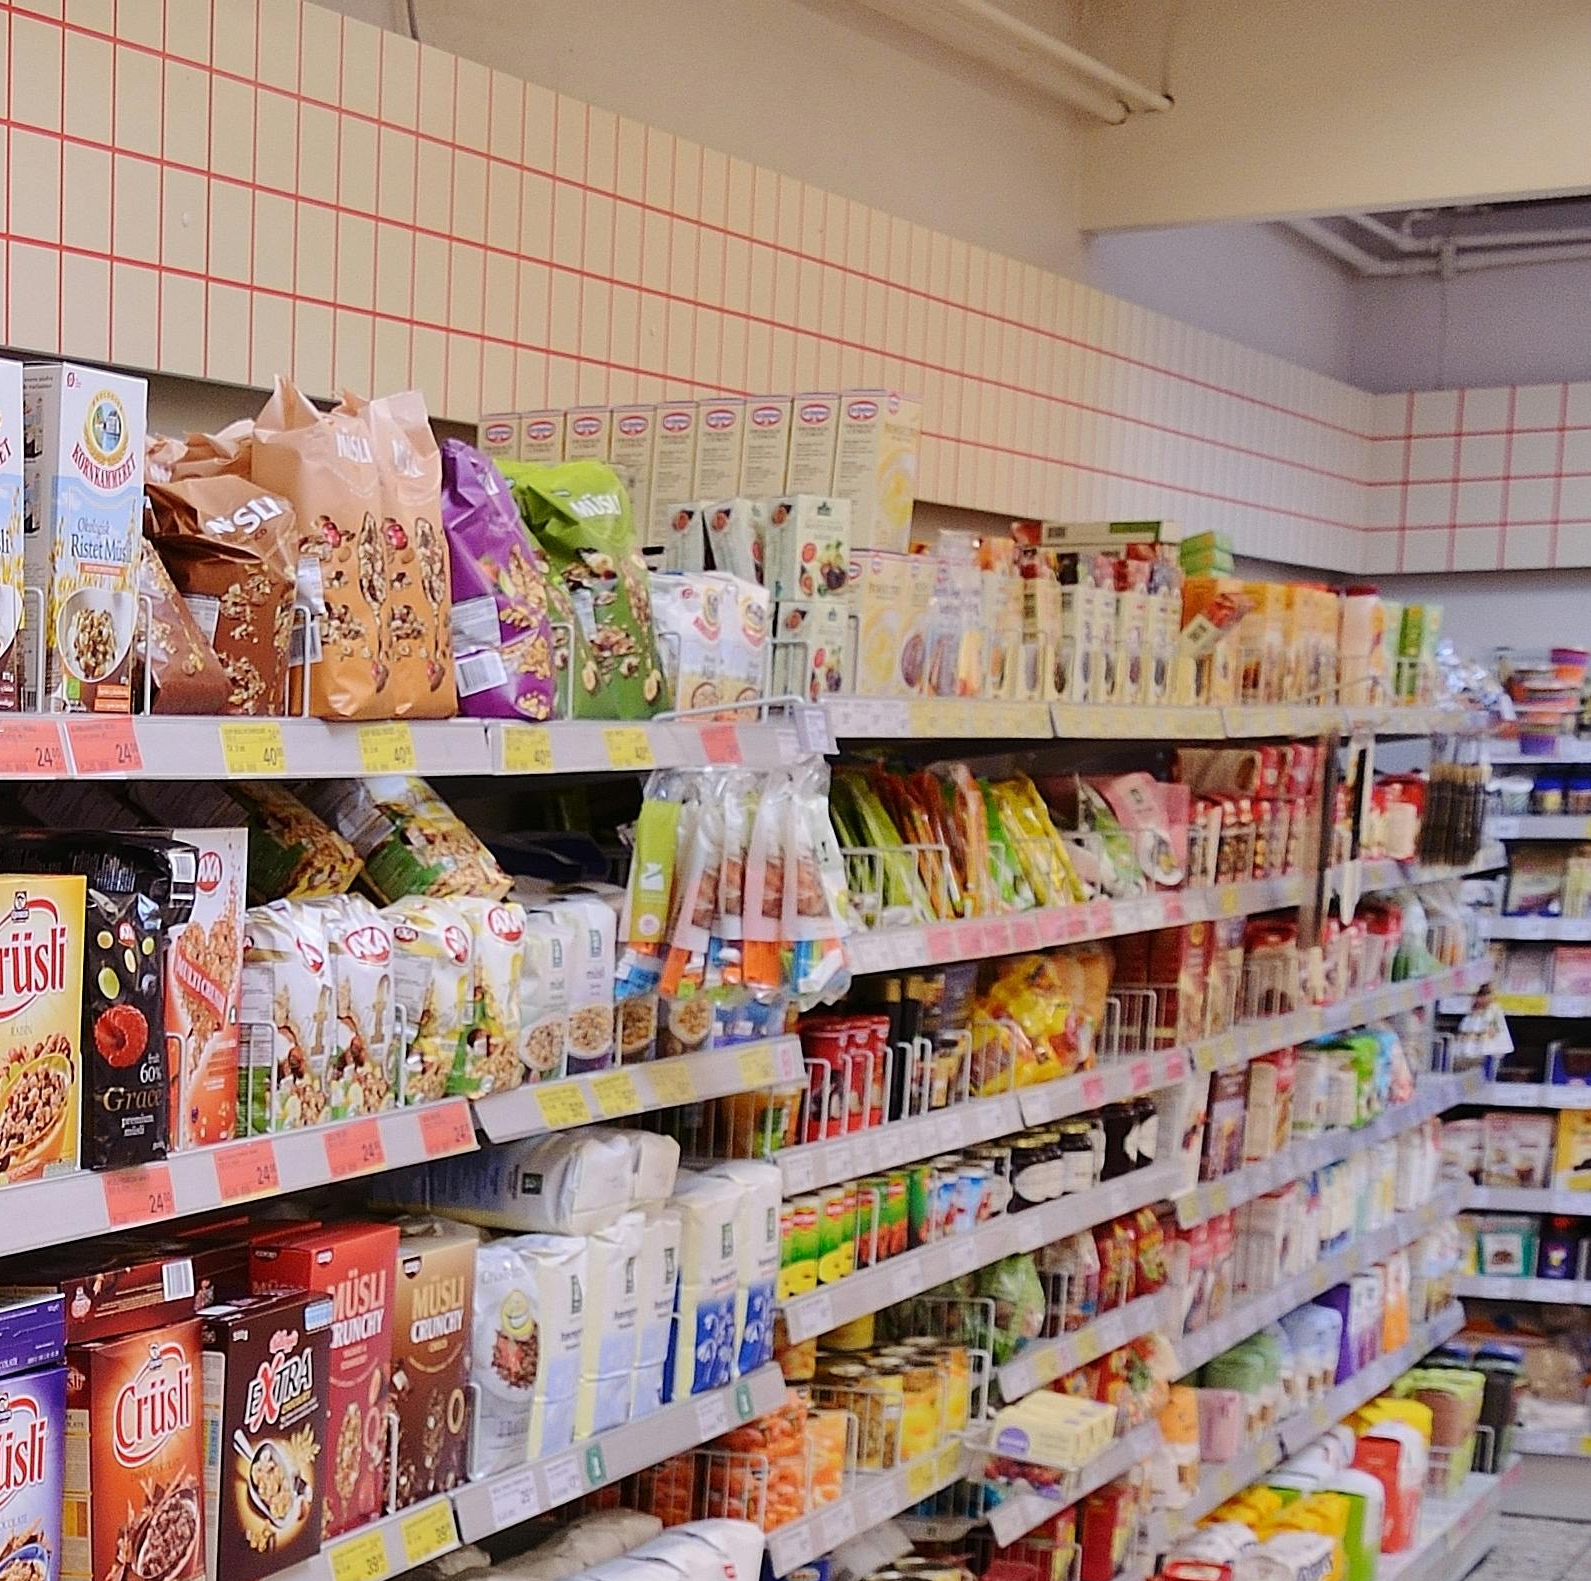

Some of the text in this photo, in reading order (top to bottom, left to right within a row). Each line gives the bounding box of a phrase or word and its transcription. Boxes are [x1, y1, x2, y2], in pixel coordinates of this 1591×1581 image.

[71, 442, 137, 490] KORNKAMMERET
[70, 533, 104, 558] Ristet
[344, 927, 392, 964] AXA
[139, 1061, 163, 1083] 60%
[103, 1086, 164, 1112] Grace
[410, 1309, 464, 1344] CRUNCHY
[245, 1349, 314, 1432] EXTRA
